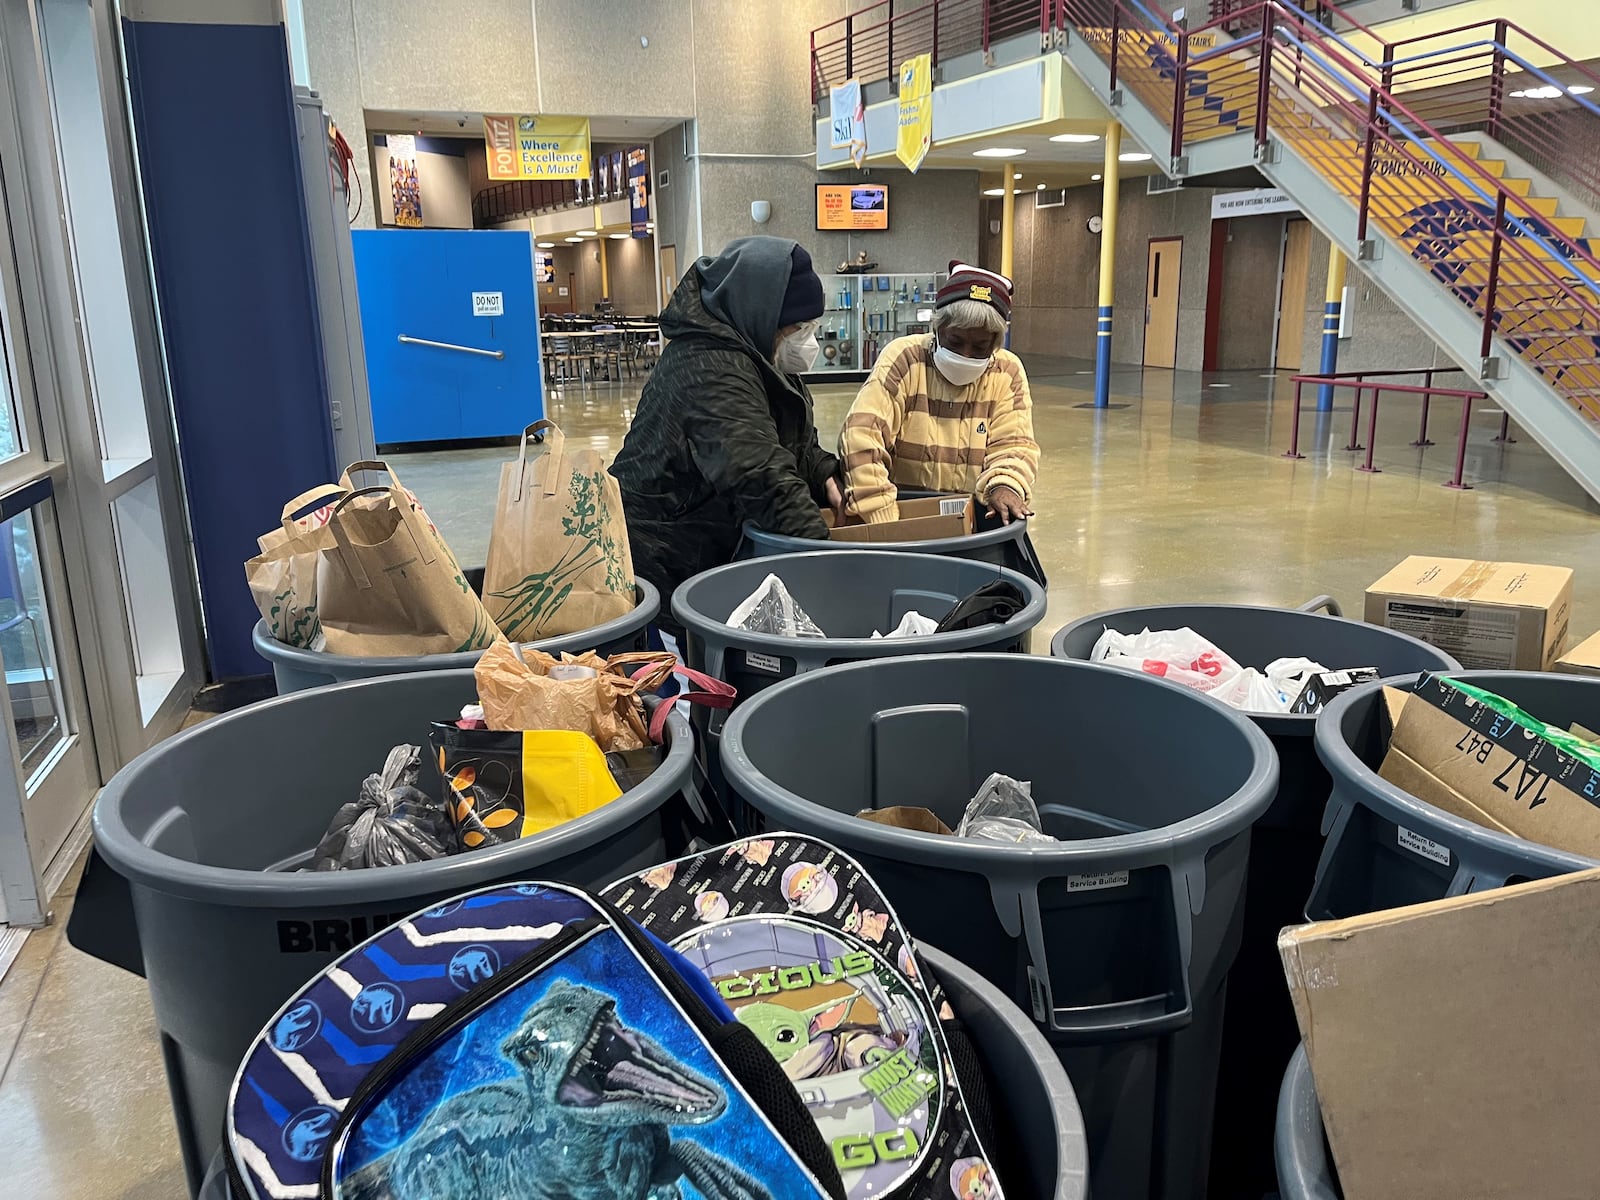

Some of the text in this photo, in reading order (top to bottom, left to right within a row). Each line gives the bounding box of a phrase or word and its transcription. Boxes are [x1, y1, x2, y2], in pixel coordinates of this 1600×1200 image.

[493, 119, 513, 174] PONITZ
[521, 140, 559, 150] Where
[522, 152, 583, 162] Excellence
[524, 163, 578, 174] Is A Must!
[1245, 198, 1263, 206] ENTERING
[476, 296, 499, 305] DO NOT
[1455, 729, 1547, 810] 1A7 B47
[1408, 831, 1436, 848] Return to
[1400, 835, 1449, 863] Service Building
[678, 852, 706, 887] UNKNOWN
[1070, 876, 1128, 888] Service Building
[277, 911, 412, 953] BRU
[861, 1049, 917, 1096] MOST
